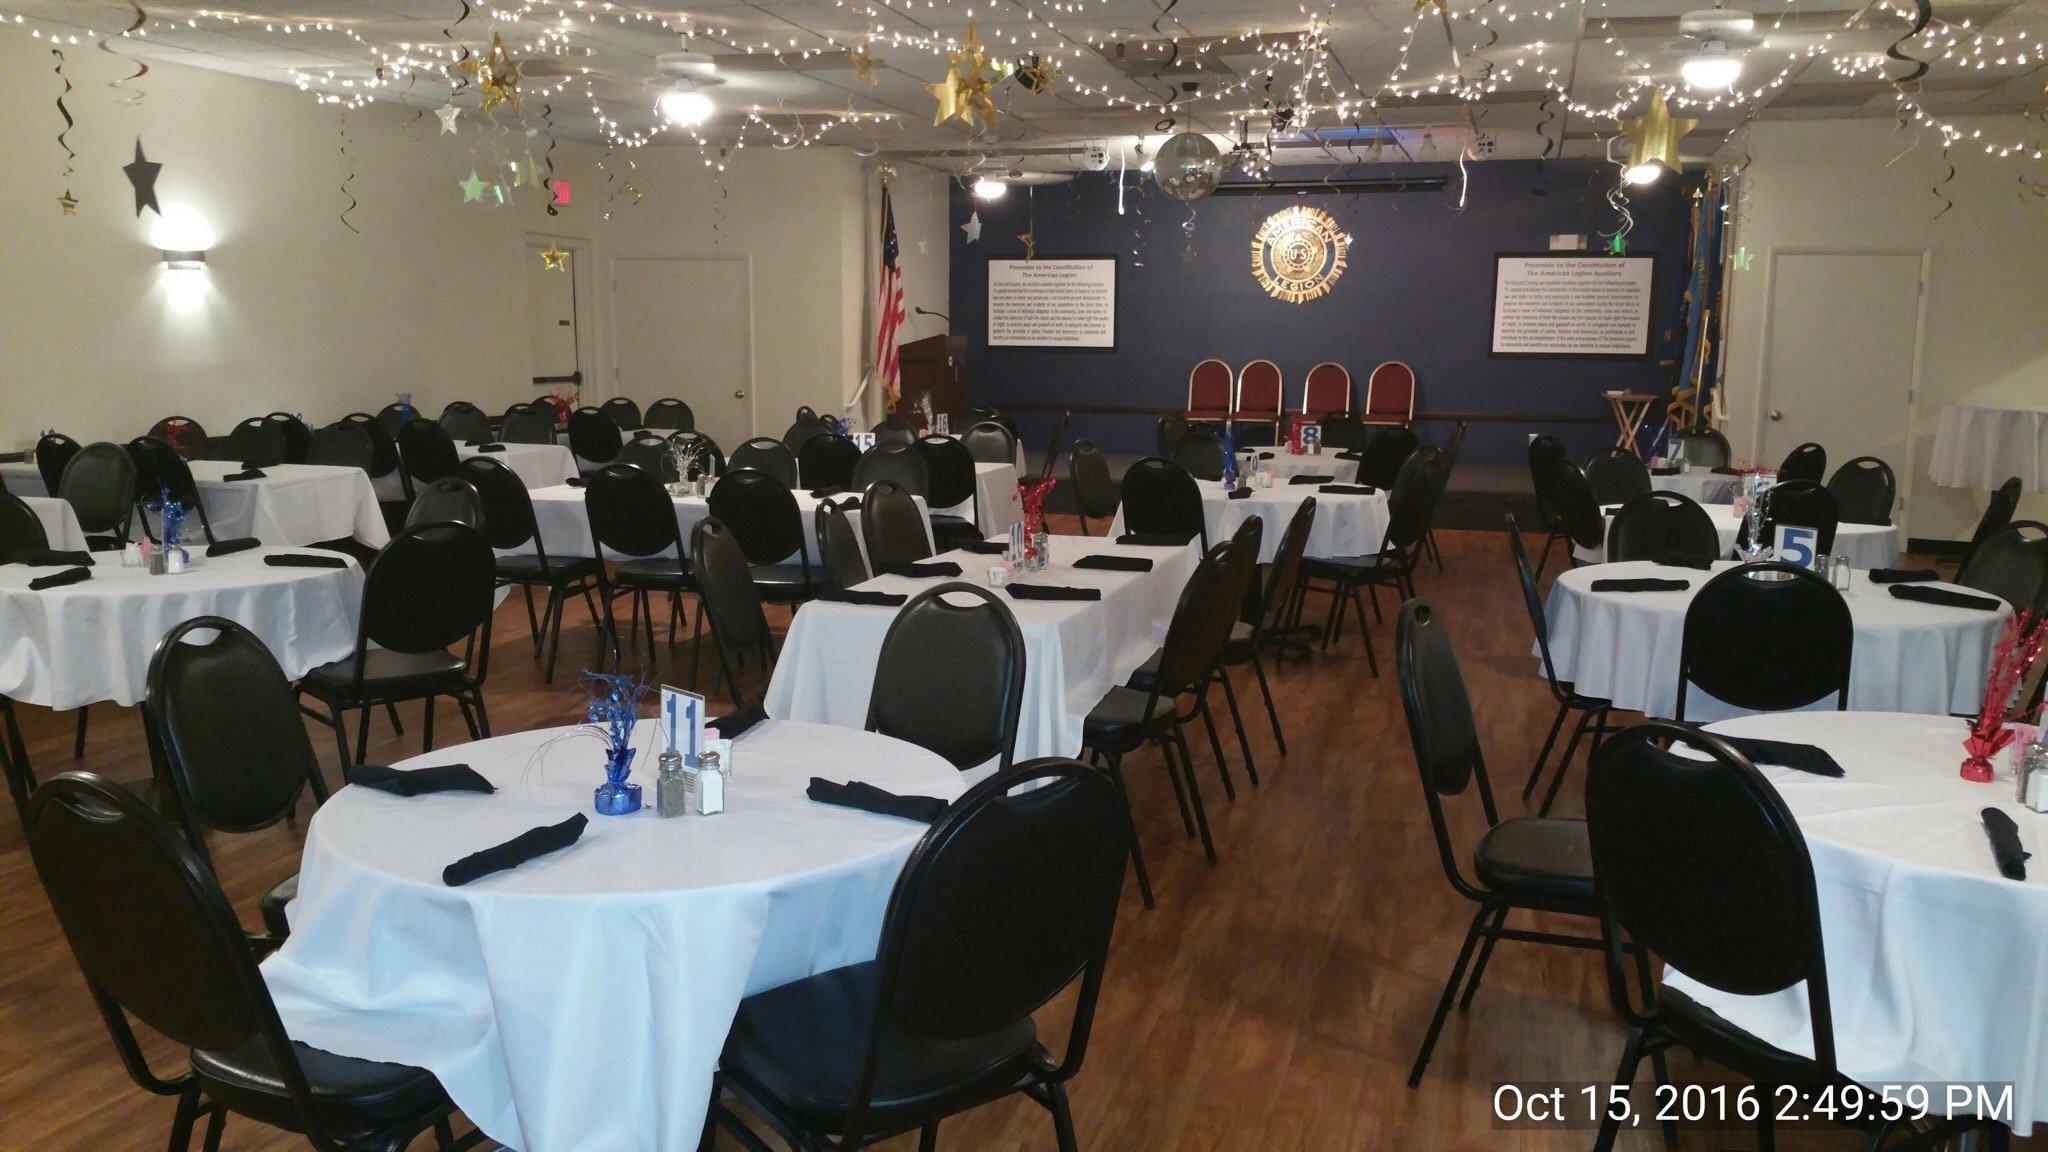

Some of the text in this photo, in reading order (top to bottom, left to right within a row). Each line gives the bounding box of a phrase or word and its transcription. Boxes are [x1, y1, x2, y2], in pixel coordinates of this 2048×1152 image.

[1266, 216, 1333, 246] AMERICAN
[1274, 272, 1325, 292] LEGION
[1571, 270, 1592, 278] Legion
[1593, 270, 1622, 278] Auxiliary
[855, 434, 872, 448] 15
[1303, 426, 1318, 445] 8
[1780, 528, 1814, 567] 5
[666, 693, 700, 769] 11
